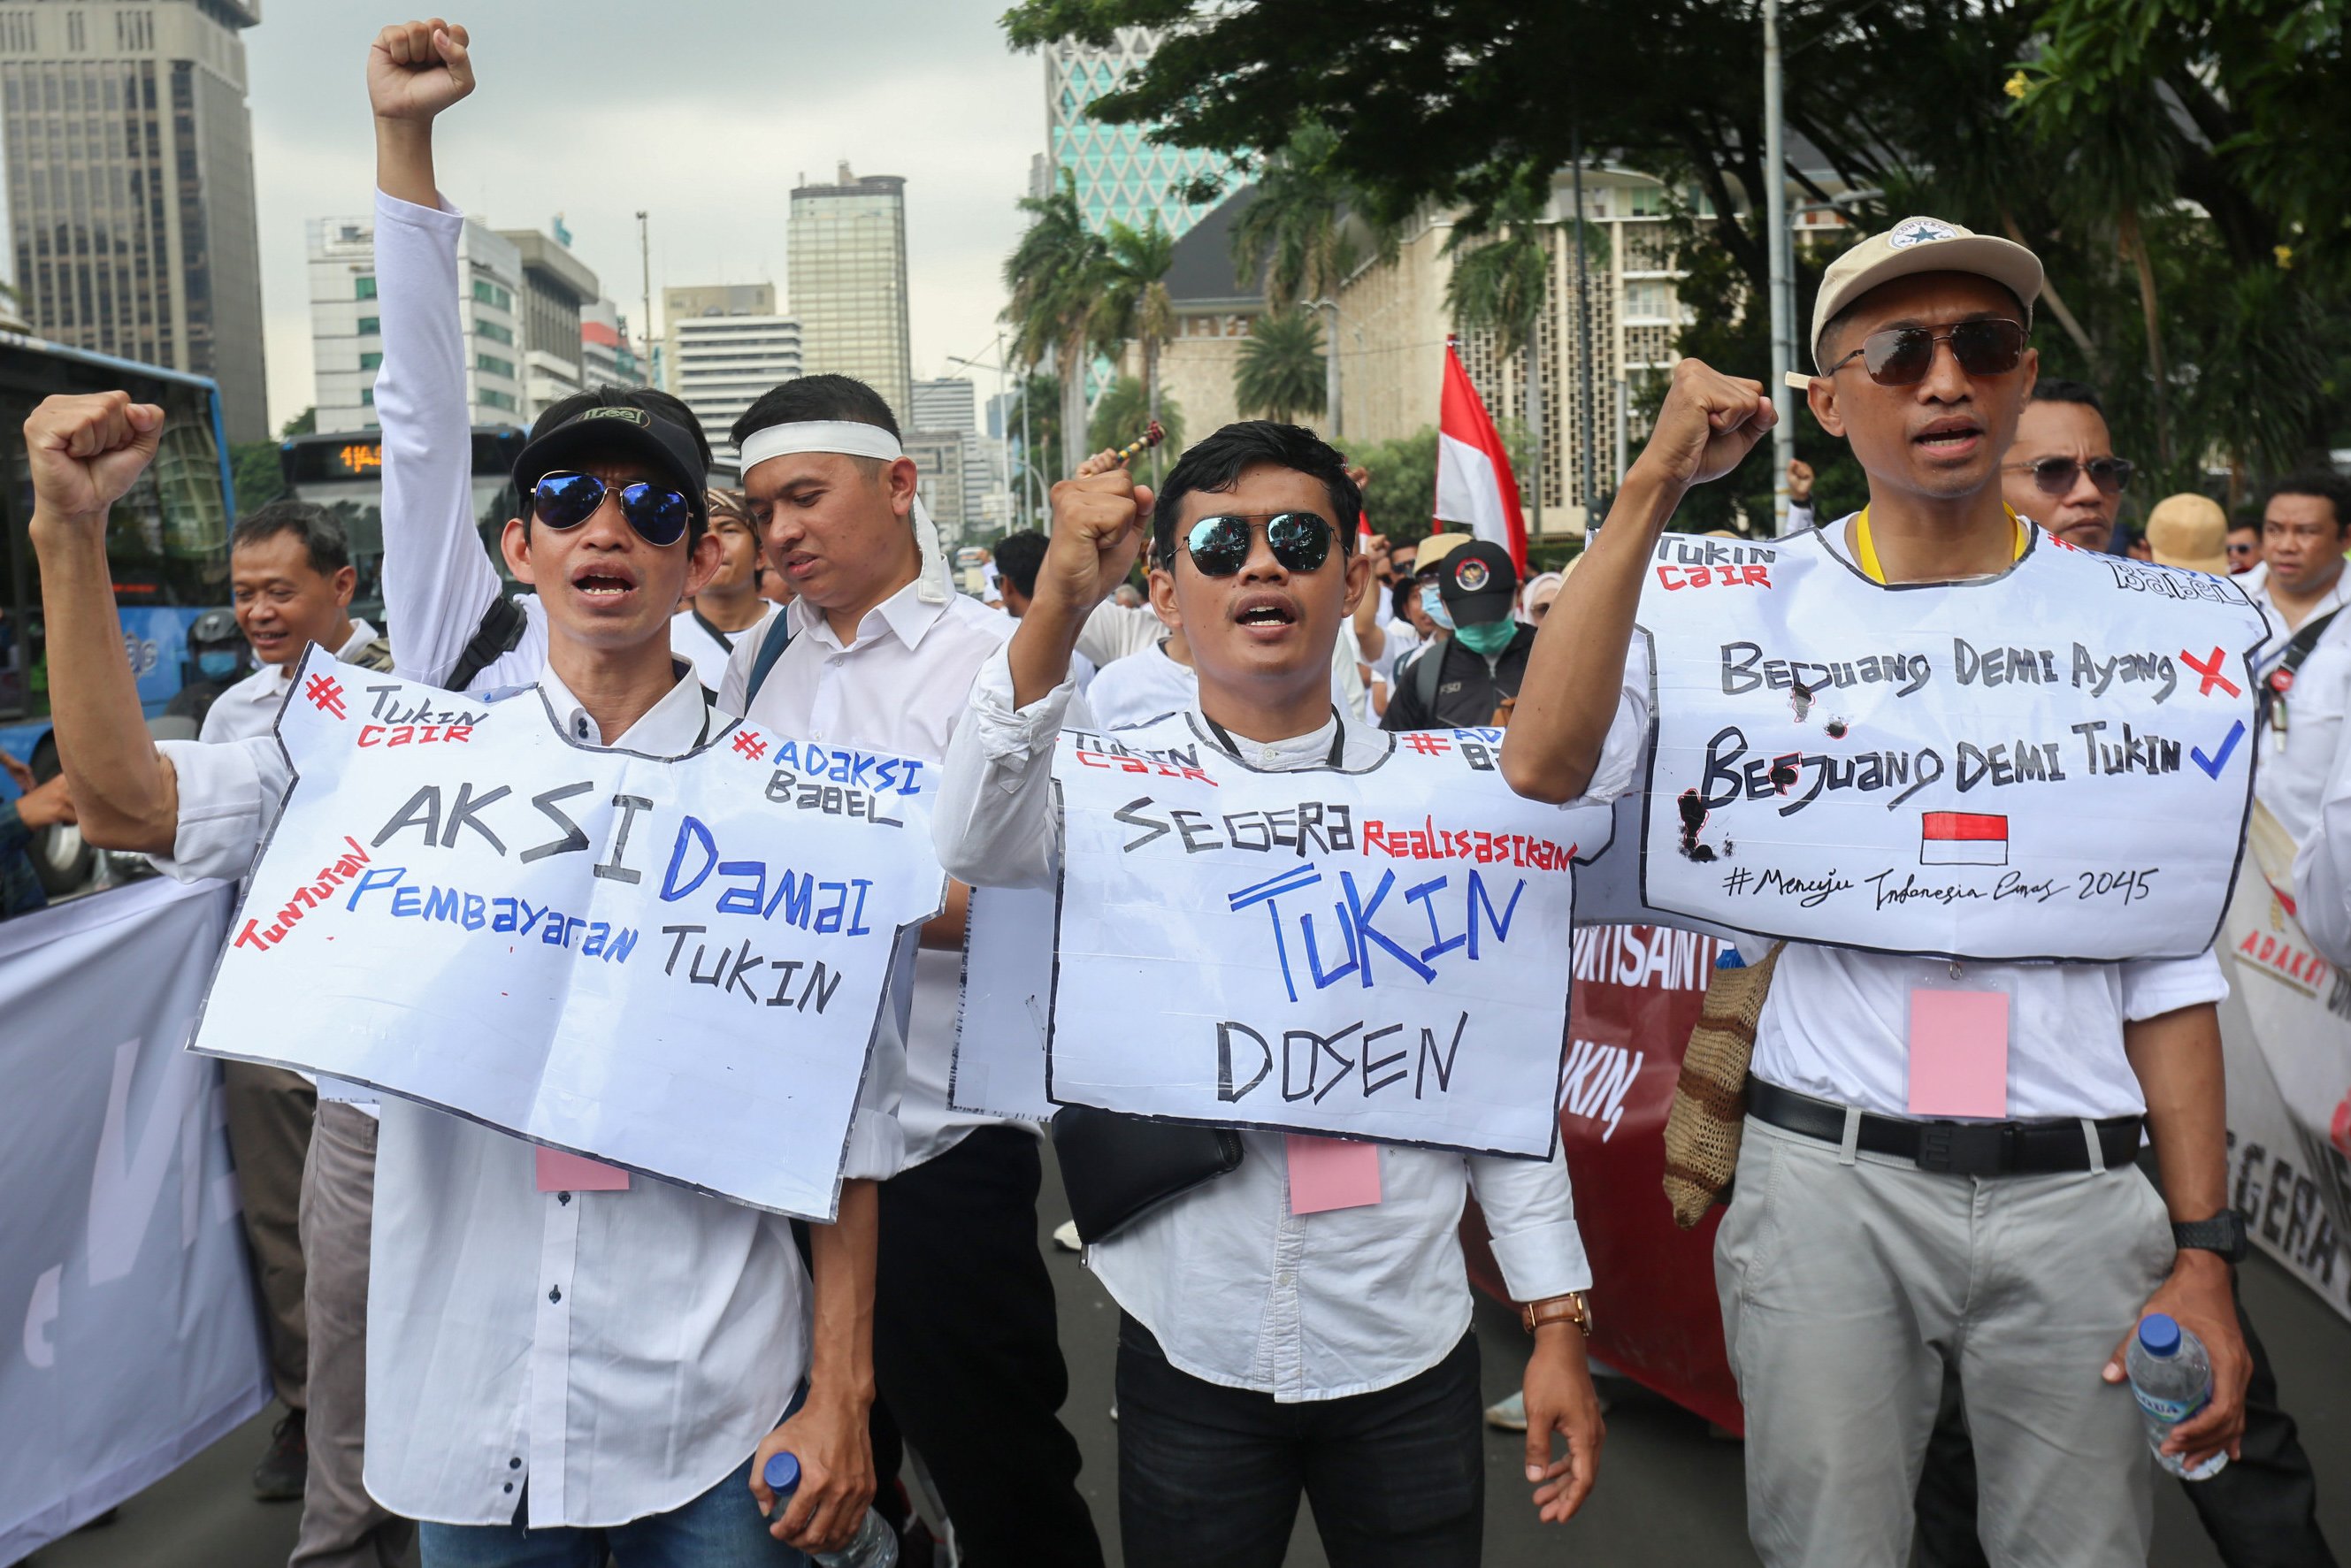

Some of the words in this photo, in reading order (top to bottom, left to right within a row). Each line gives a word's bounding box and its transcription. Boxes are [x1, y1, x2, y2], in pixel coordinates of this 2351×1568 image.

[1954, 638, 2059, 688] DEMI
[1956, 738, 2066, 793] DEMI
[371, 781, 653, 884] AKSI
[1865, 868, 1988, 910] Indonesia
[2078, 868, 2159, 906] 2045
[1216, 1011, 1469, 1105] DOSEN
